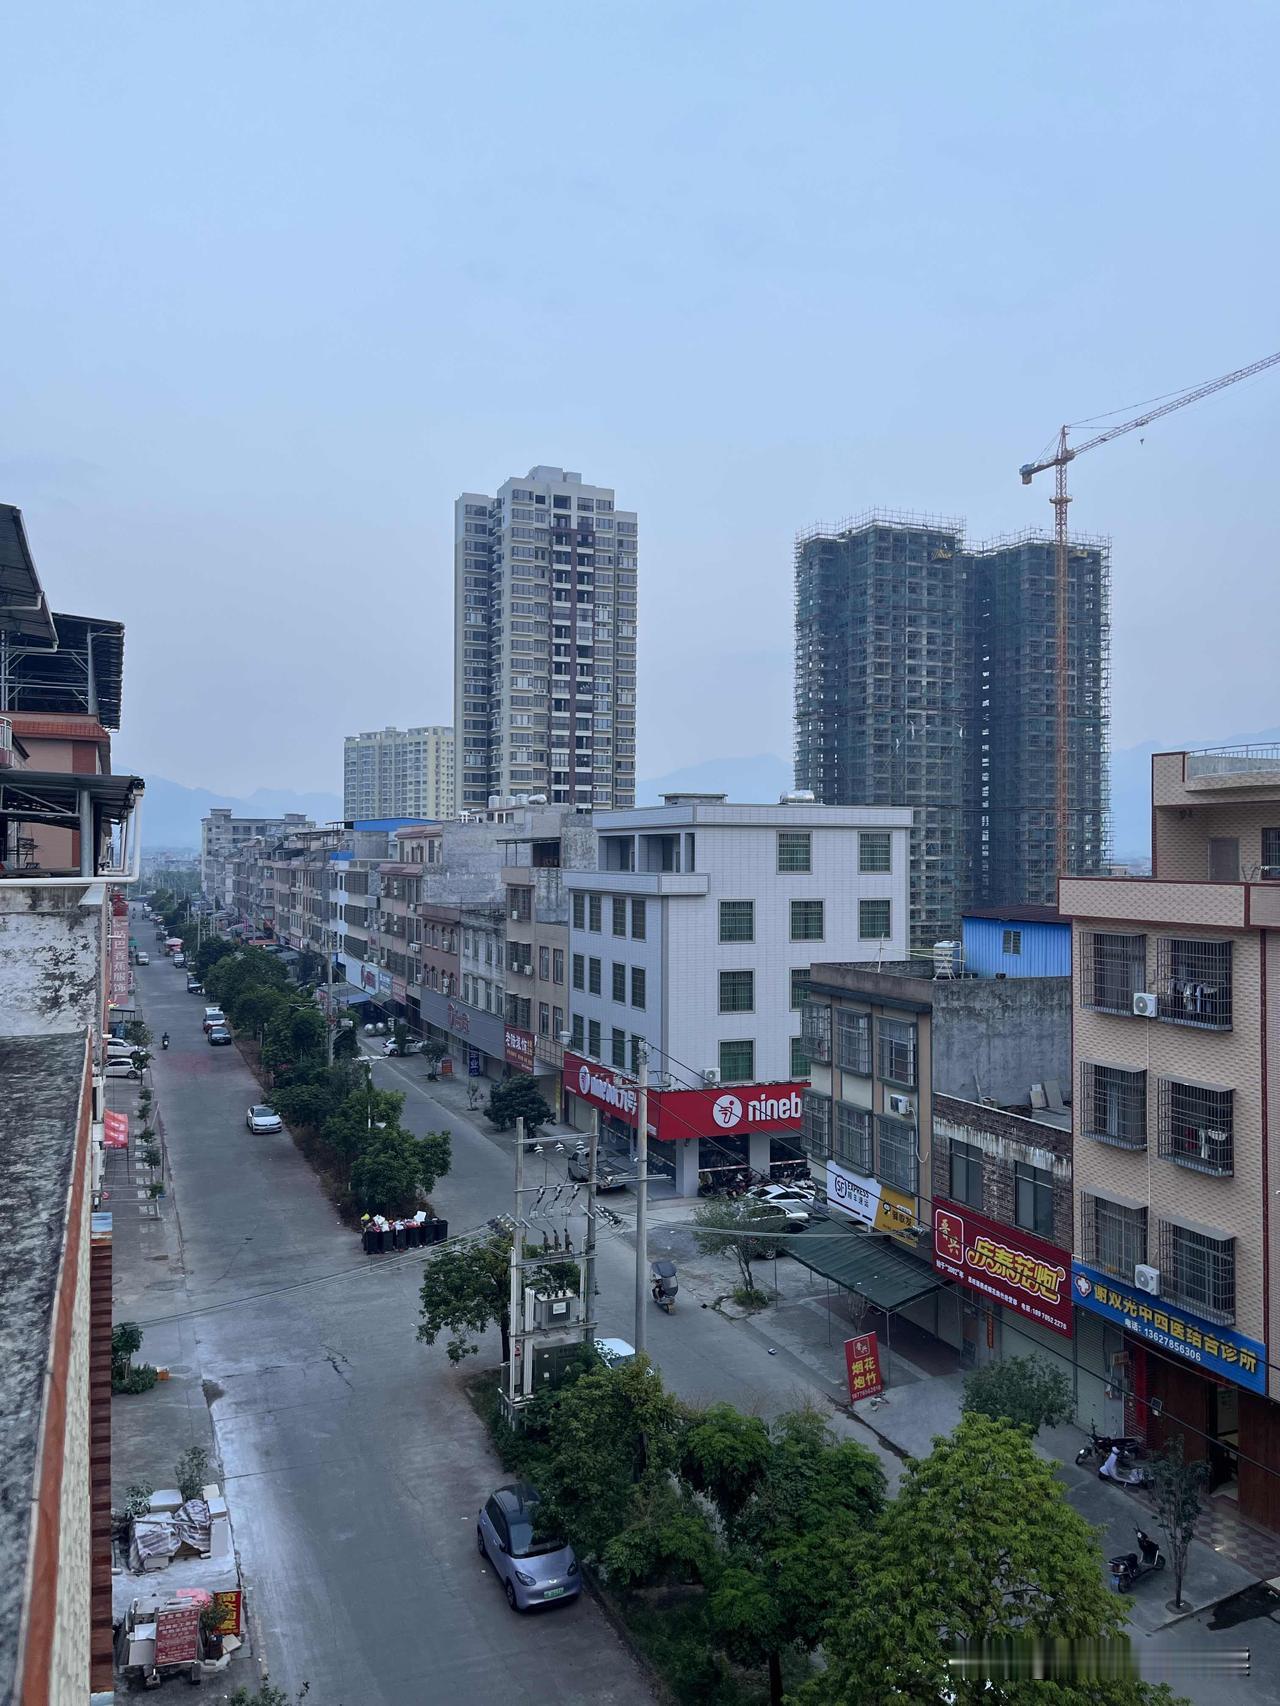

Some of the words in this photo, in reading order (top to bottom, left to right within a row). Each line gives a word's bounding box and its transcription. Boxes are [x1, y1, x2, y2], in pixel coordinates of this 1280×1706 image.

[748, 1092, 801, 1121] nineb
[848, 1183, 870, 1199] EXPRESS
[1144, 1328, 1201, 1362] 13627856306
[852, 1356, 876, 1376] 烟花
